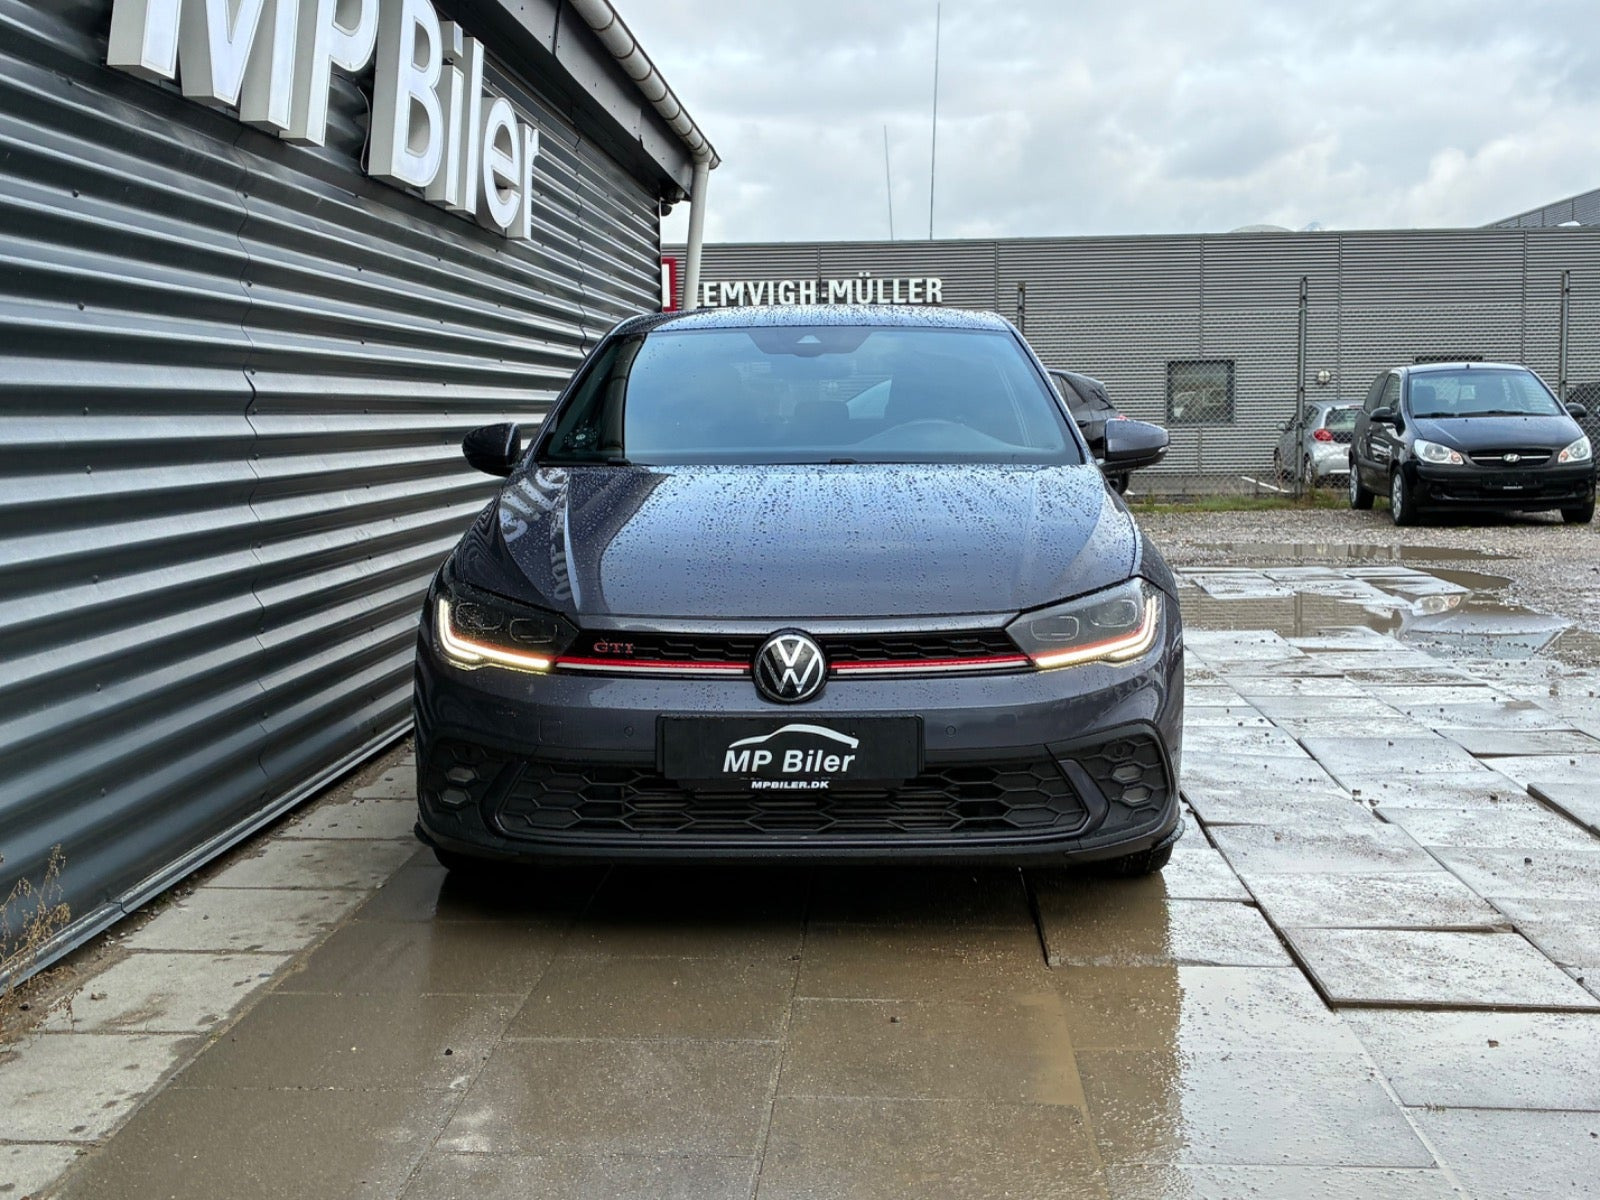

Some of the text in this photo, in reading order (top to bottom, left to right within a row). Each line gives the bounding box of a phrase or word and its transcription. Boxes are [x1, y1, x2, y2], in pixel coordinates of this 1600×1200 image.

[697, 272, 943, 307] EMVIGH-MÜLLER
[593, 641, 634, 655] GTI
[723, 750, 856, 773] MP Biler
[751, 780, 830, 789] MPBILER.DK
